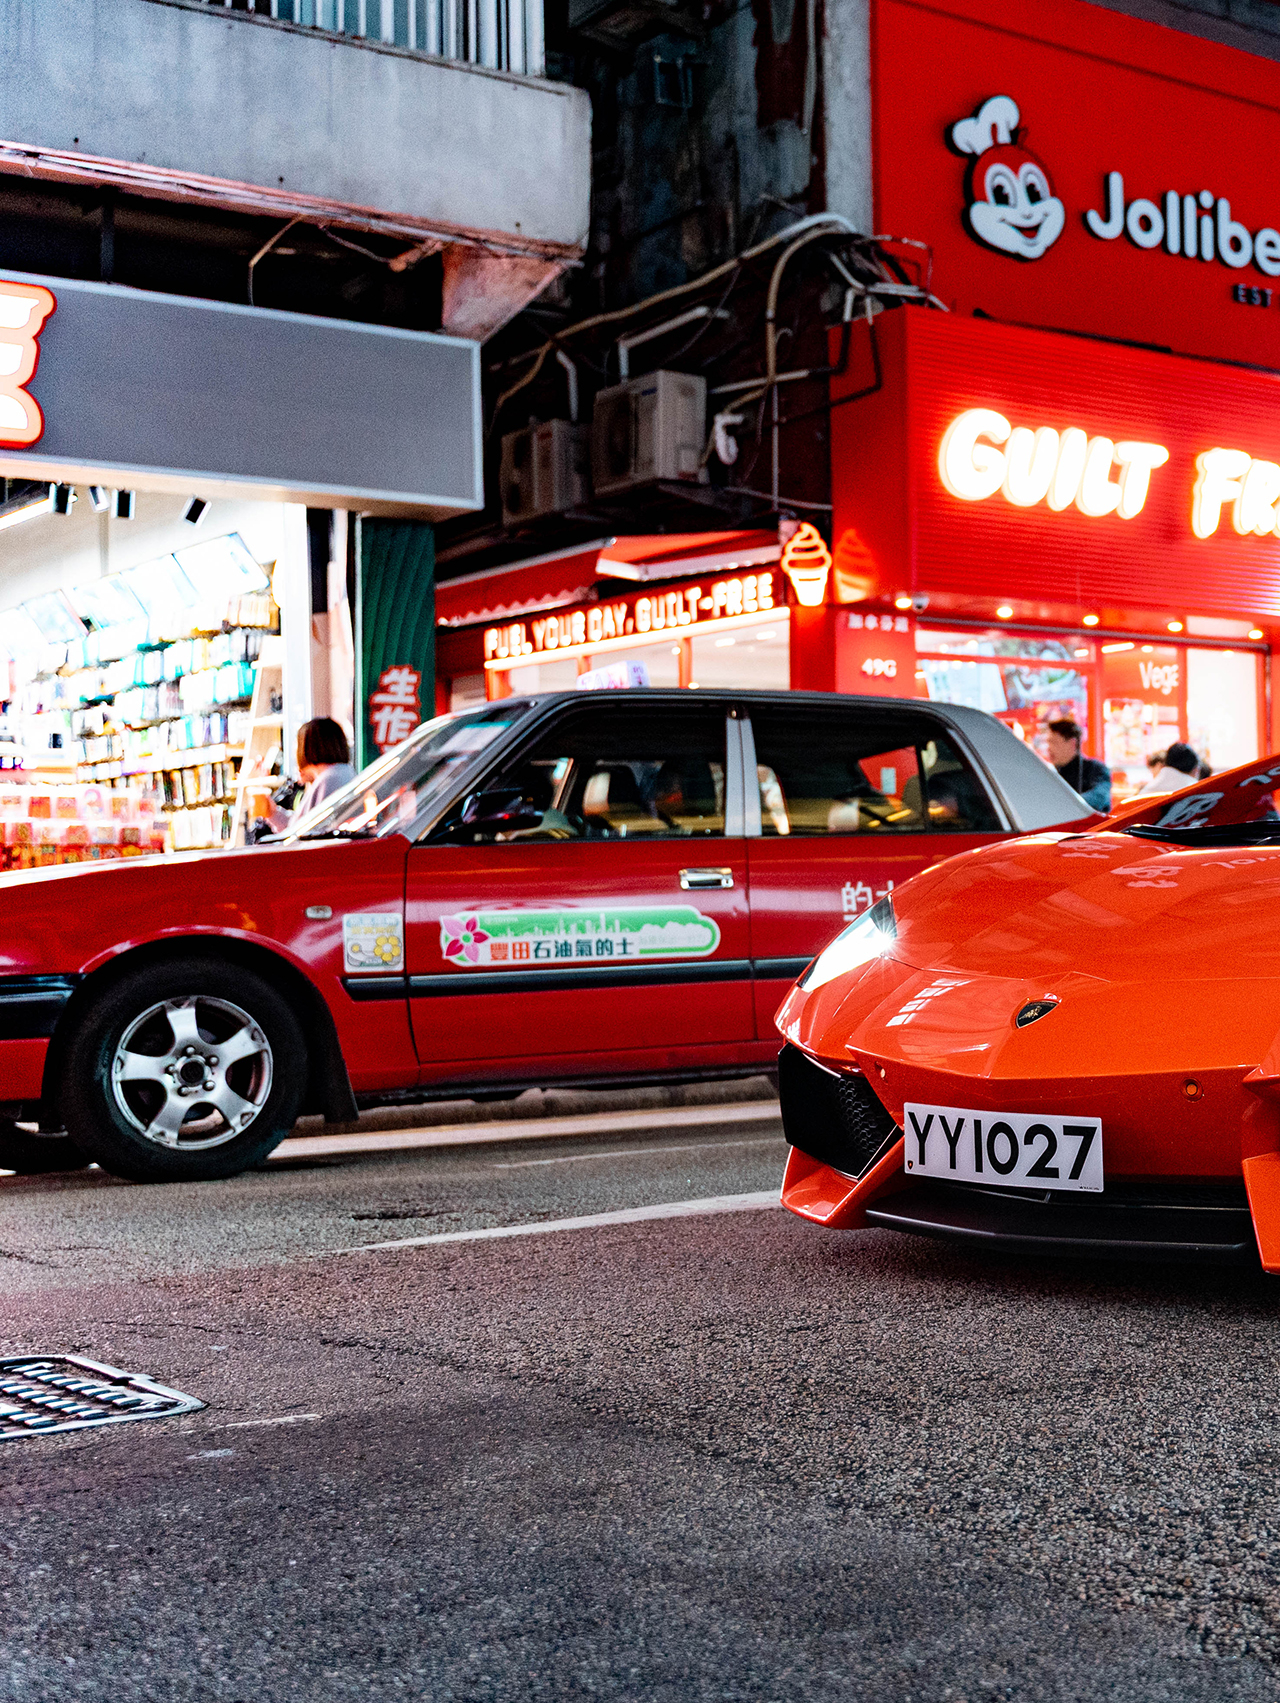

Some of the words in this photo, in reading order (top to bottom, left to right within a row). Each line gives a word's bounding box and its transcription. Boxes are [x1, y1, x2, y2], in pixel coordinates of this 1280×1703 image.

[1235, 283, 1273, 308] EST
[938, 408, 1169, 519] GUILT
[484, 623, 533, 660] FUEL
[532, 611, 586, 651] YOUR
[635, 573, 774, 633] GUILT-FREE
[861, 658, 897, 678] 49G
[490, 937, 634, 962] 豐田石油氣的士
